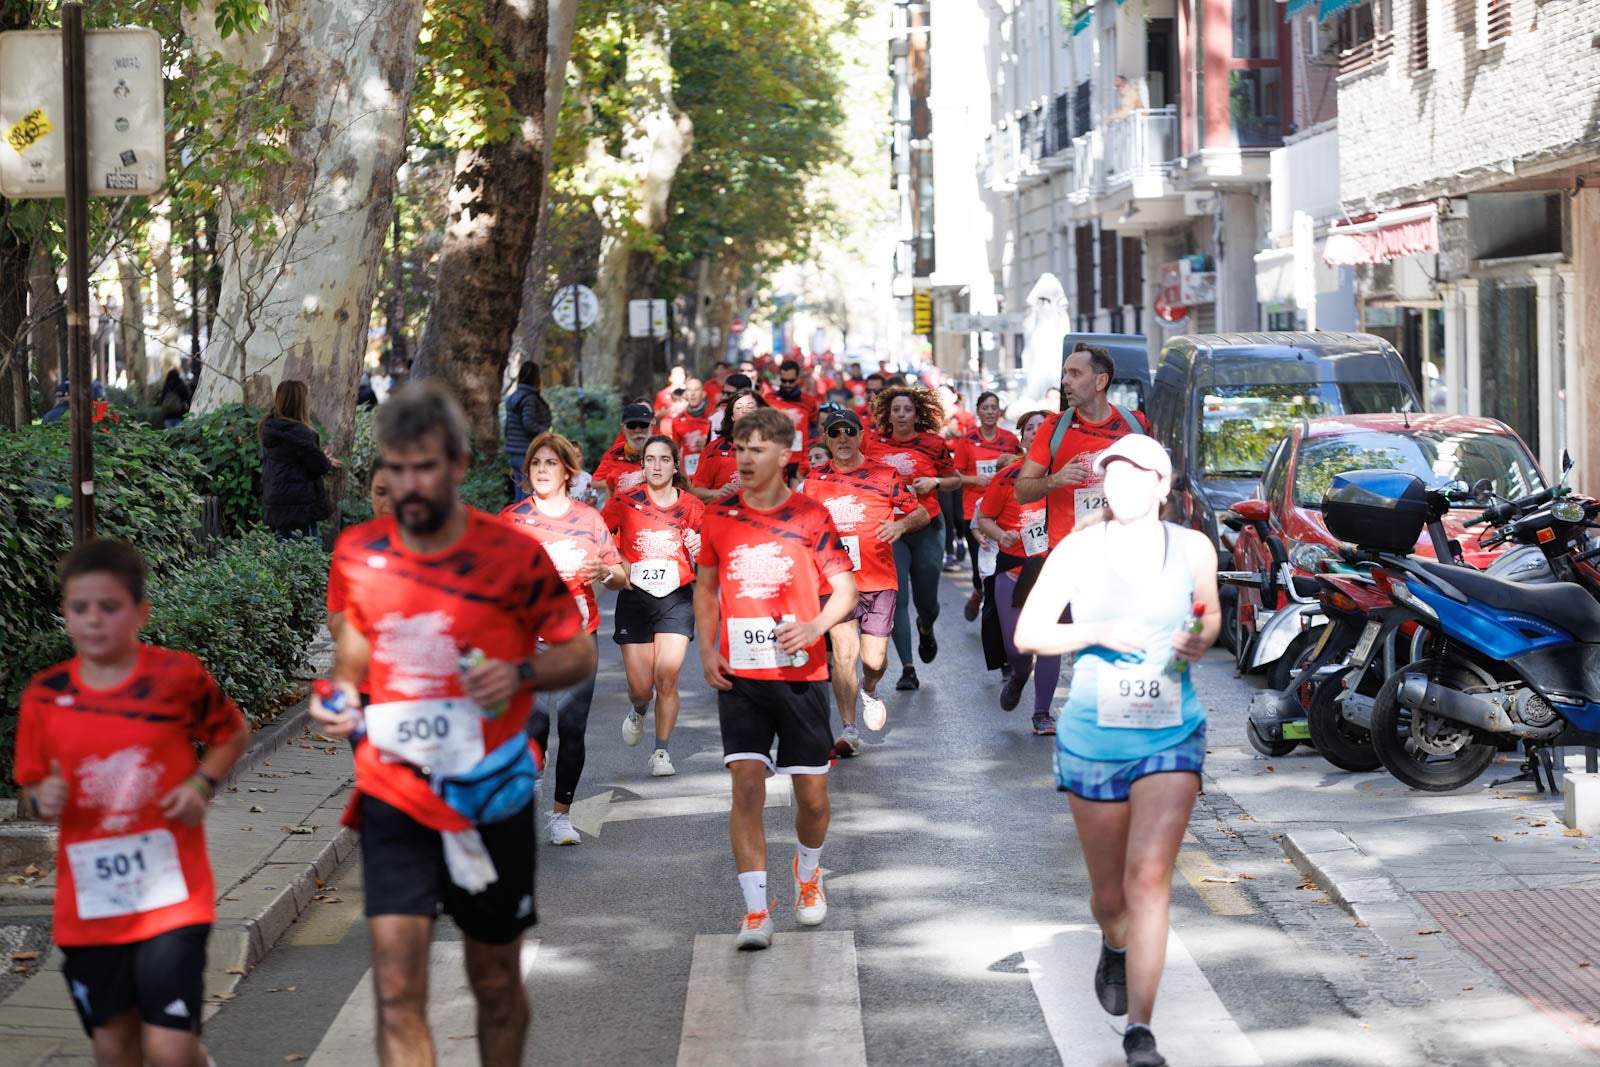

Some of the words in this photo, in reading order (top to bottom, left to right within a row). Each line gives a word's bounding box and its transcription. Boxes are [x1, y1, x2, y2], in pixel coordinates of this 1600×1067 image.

[642, 569, 666, 580] 237
[744, 629, 778, 645] 964
[1119, 679, 1160, 698] 938
[398, 715, 450, 743] 500
[95, 850, 147, 880] 501
